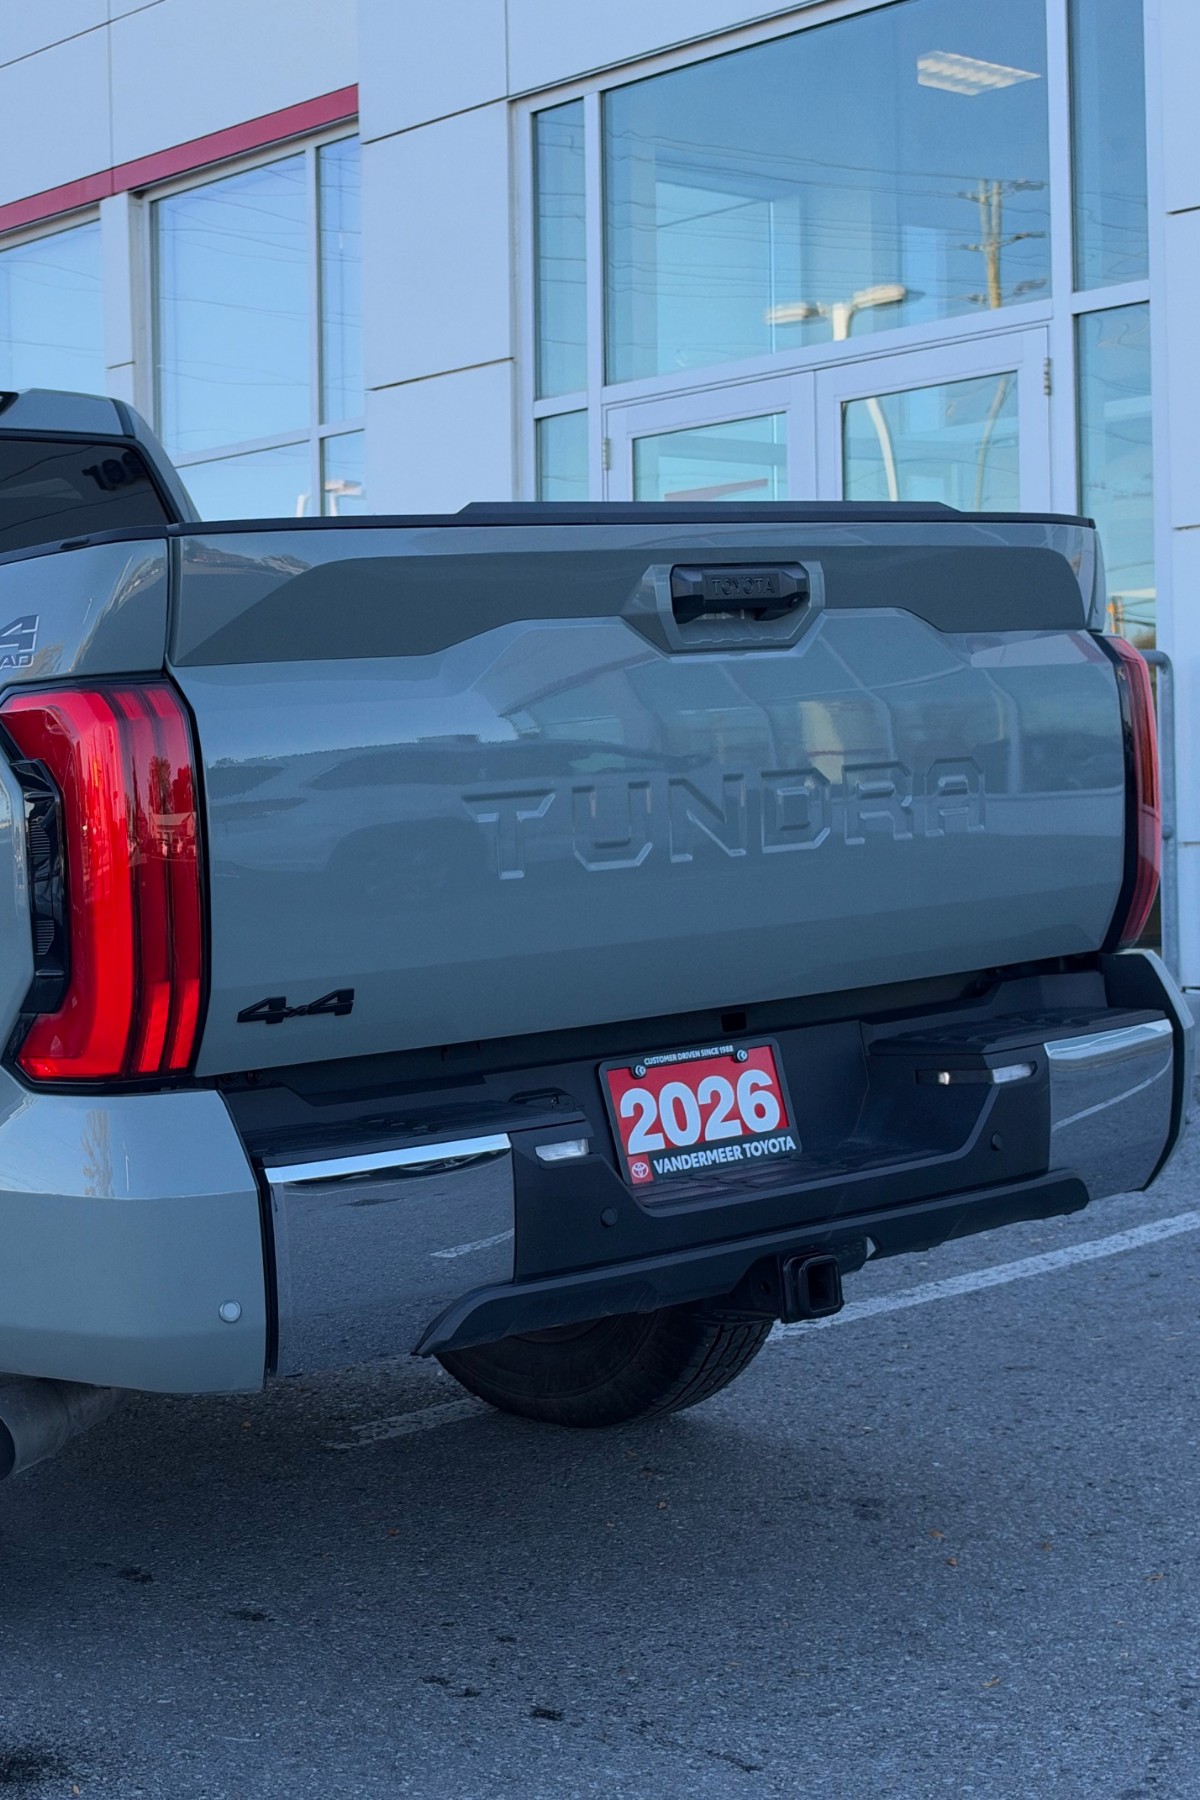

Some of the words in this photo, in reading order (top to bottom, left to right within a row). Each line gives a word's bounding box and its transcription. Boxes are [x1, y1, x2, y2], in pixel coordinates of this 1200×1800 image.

[711, 577, 776, 596] TOYOTA
[461, 757, 986, 880] TUNDRA
[237, 988, 355, 1025] 4x4
[643, 1053, 677, 1066] CUSTOMER
[677, 1050, 701, 1061] DRIVEN
[700, 1046, 720, 1058] SINCE
[619, 1068, 781, 1156] 2026
[652, 1144, 743, 1175] VANDERMEER
[743, 1135, 797, 1159] TOYOTA
